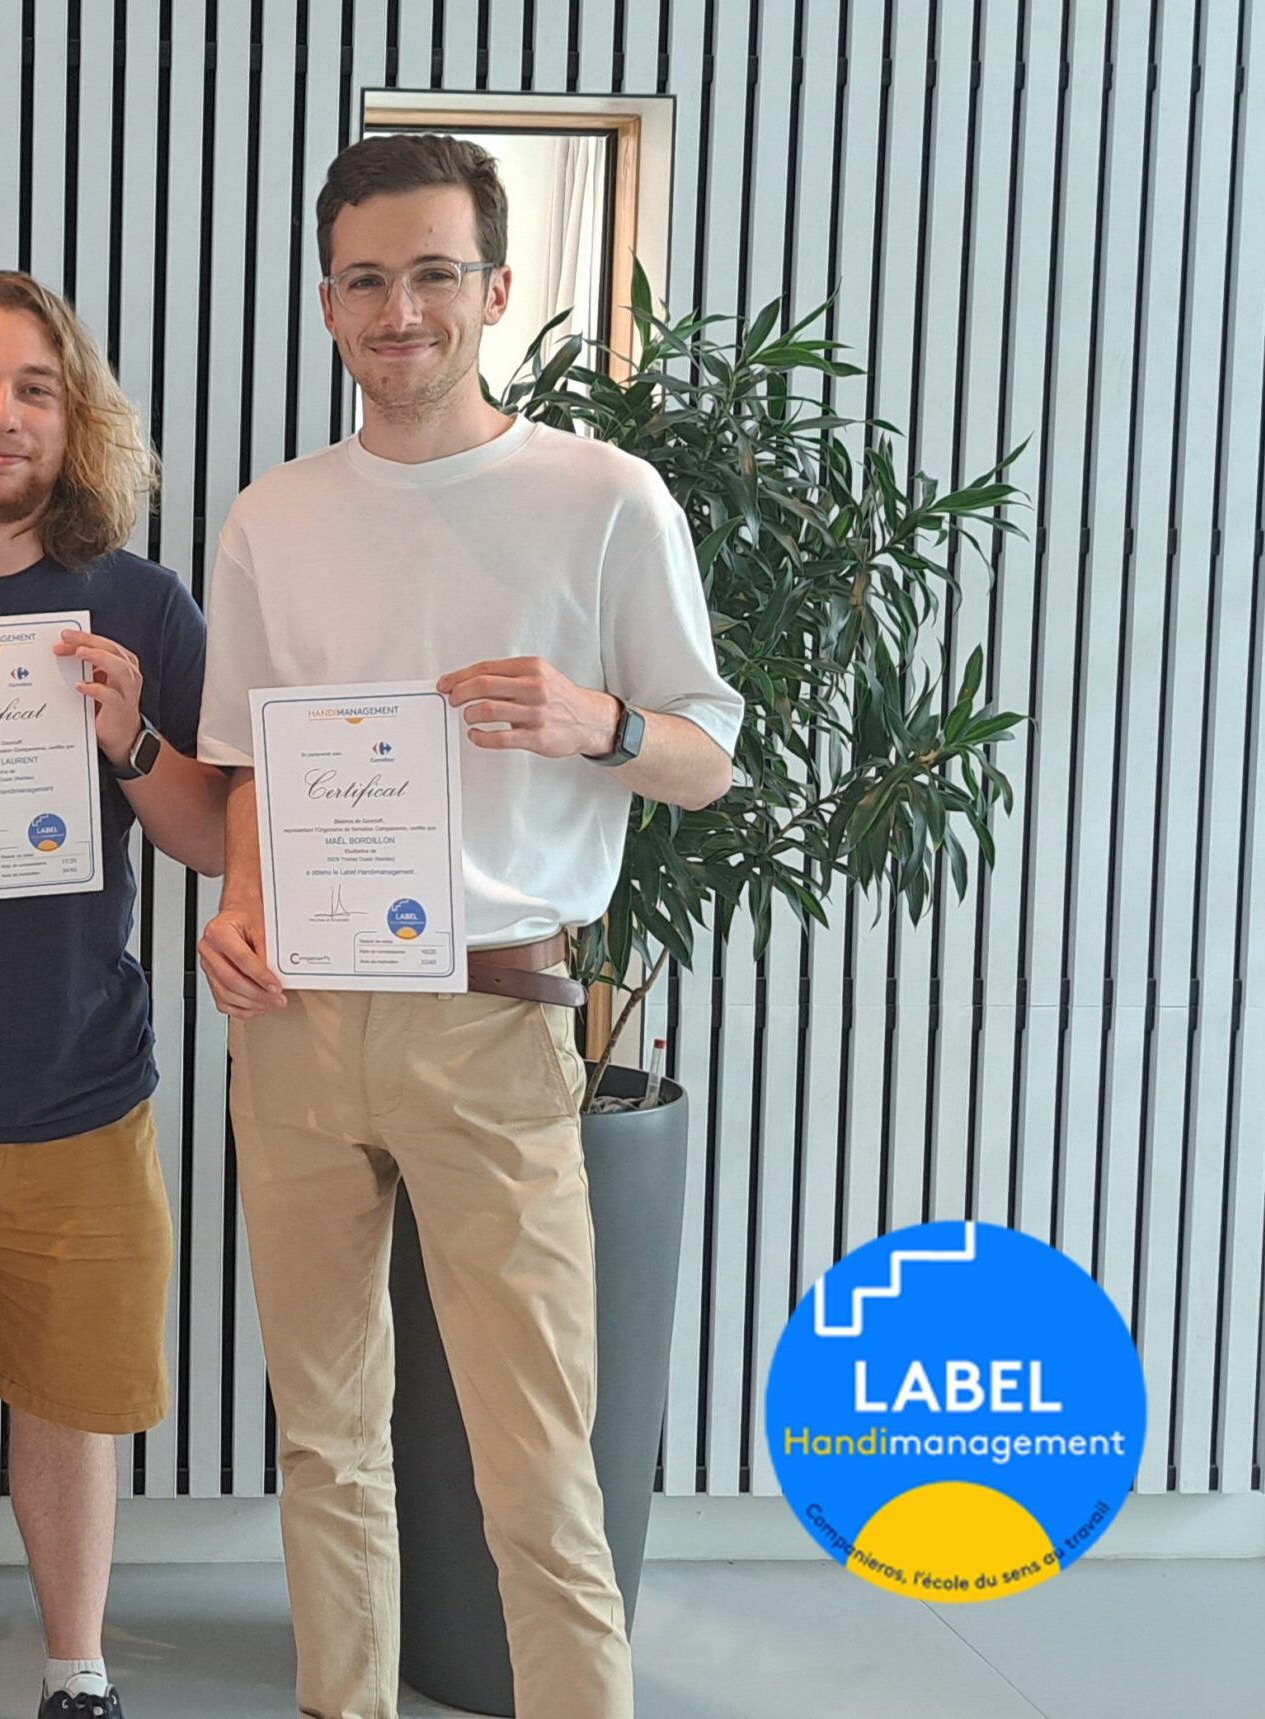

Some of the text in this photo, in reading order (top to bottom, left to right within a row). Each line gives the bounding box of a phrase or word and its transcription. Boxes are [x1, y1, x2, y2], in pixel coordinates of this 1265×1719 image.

[308, 705, 399, 718] HANDIMANAGEMENT
[1, 756, 39, 765] LAURENT
[304, 768, 410, 808] Certificat
[36, 826, 58, 834] LABEL
[325, 836, 396, 845] MAËL BORDILLON
